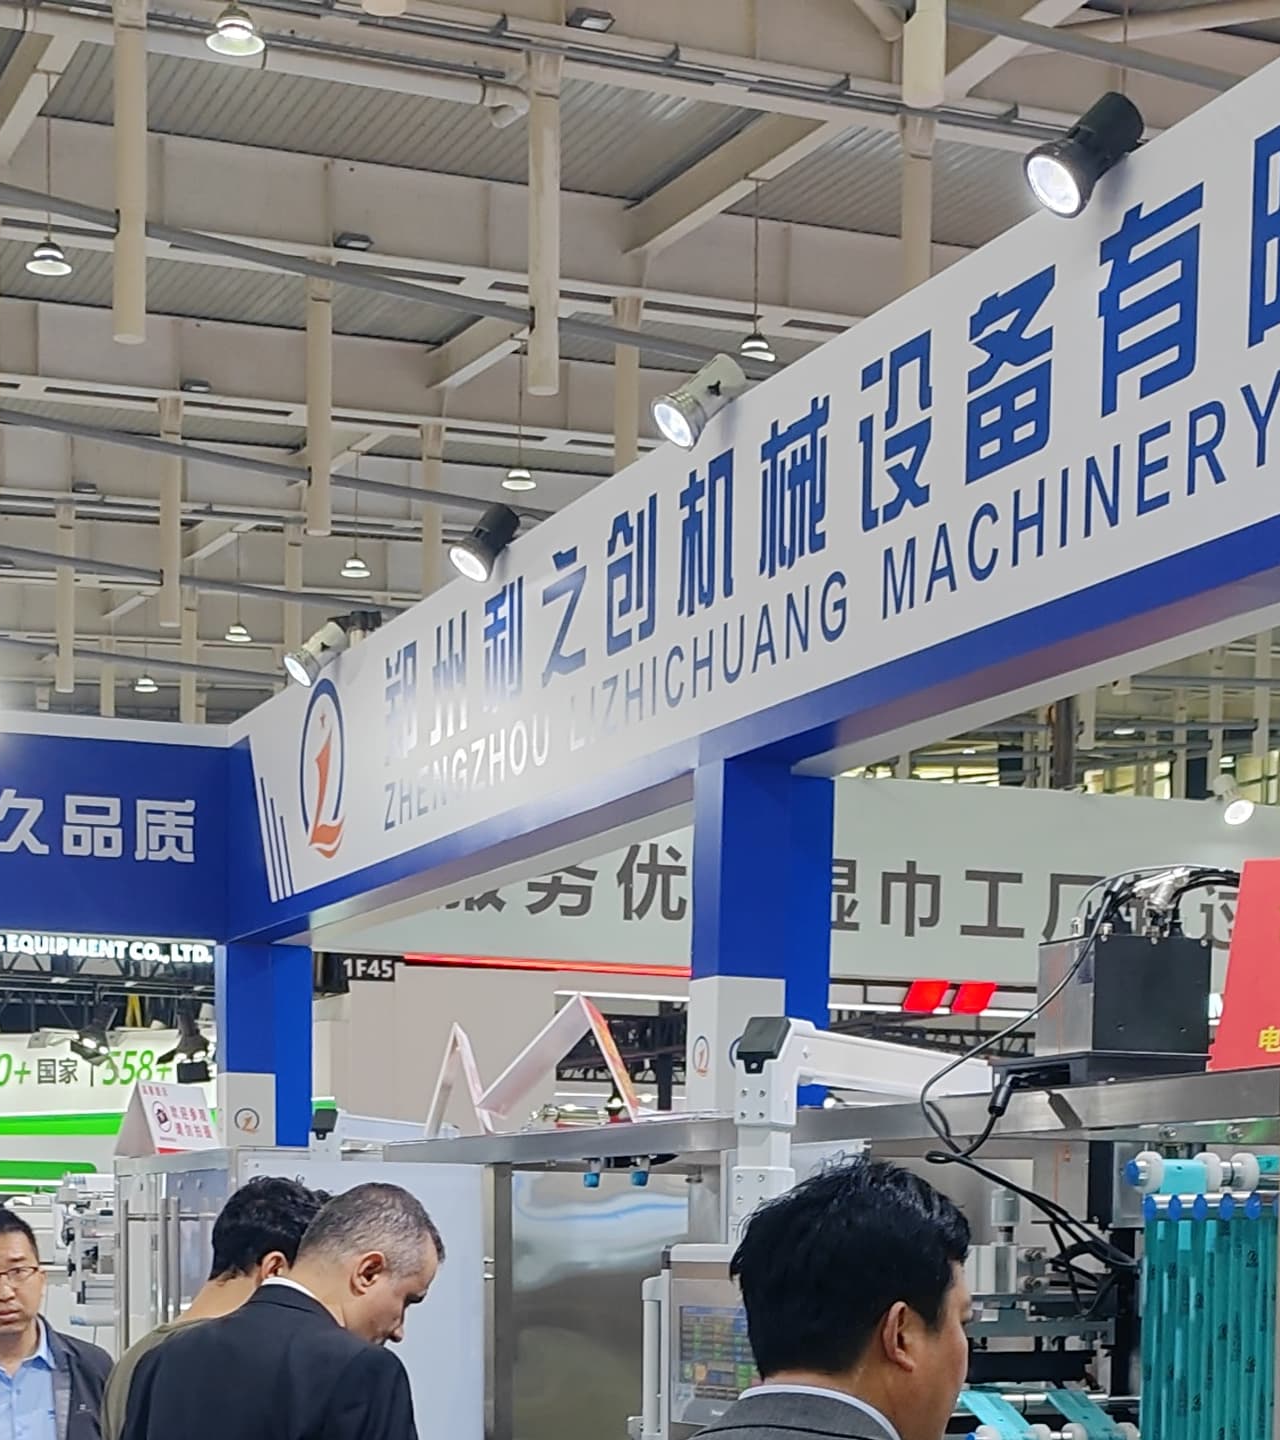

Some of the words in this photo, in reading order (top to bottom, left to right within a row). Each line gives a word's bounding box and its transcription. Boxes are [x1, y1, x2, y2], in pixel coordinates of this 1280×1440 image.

[384, 712, 550, 832] ZHENGZHOU
[569, 571, 848, 753] LIZHICHUANG
[7, 933, 129, 960] EQUIPMENT
[171, 942, 214, 964] LTD.
[342, 957, 394, 979] 1F45
[36, 1058, 78, 1085] 国家
